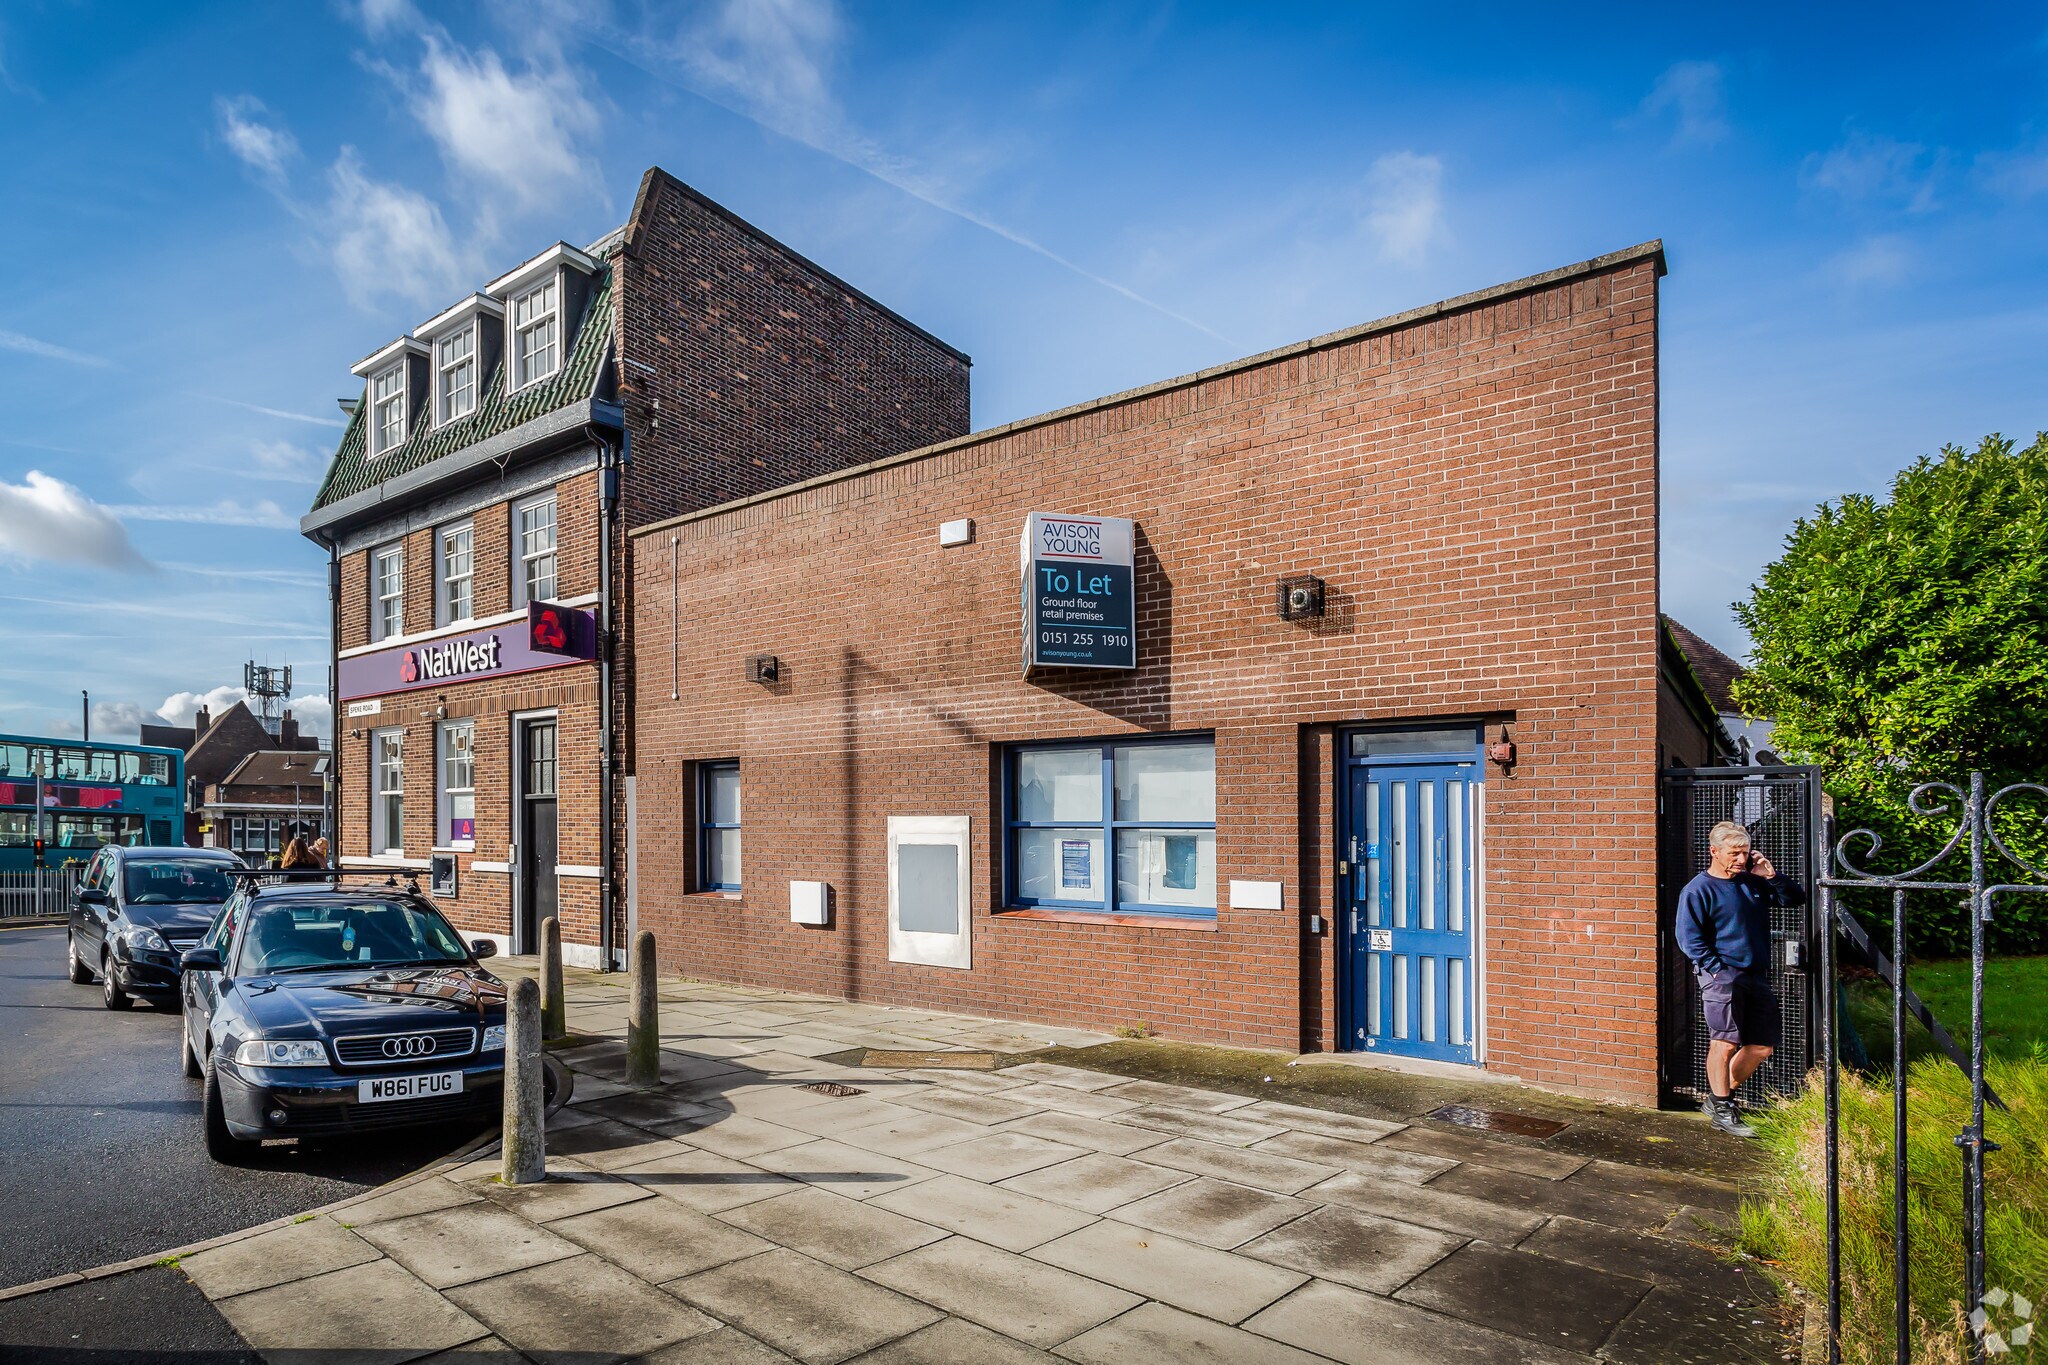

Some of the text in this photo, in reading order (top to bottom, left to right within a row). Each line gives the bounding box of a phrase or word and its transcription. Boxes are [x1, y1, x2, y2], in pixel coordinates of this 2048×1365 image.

[1043, 523, 1100, 540] AVISON
[1043, 538, 1100, 555] YOUNG
[1041, 568, 1112, 596] To Let
[1042, 597, 1098, 609] Ground floor
[1042, 609, 1104, 622] retail premises
[1041, 632, 1128, 647] 0151 255 1910
[420, 634, 497, 680] NatWest
[1041, 649, 1093, 658] avisonyoung.co.uk
[362, 704, 374, 712] ROAD
[372, 1074, 452, 1098] W861 FUG
